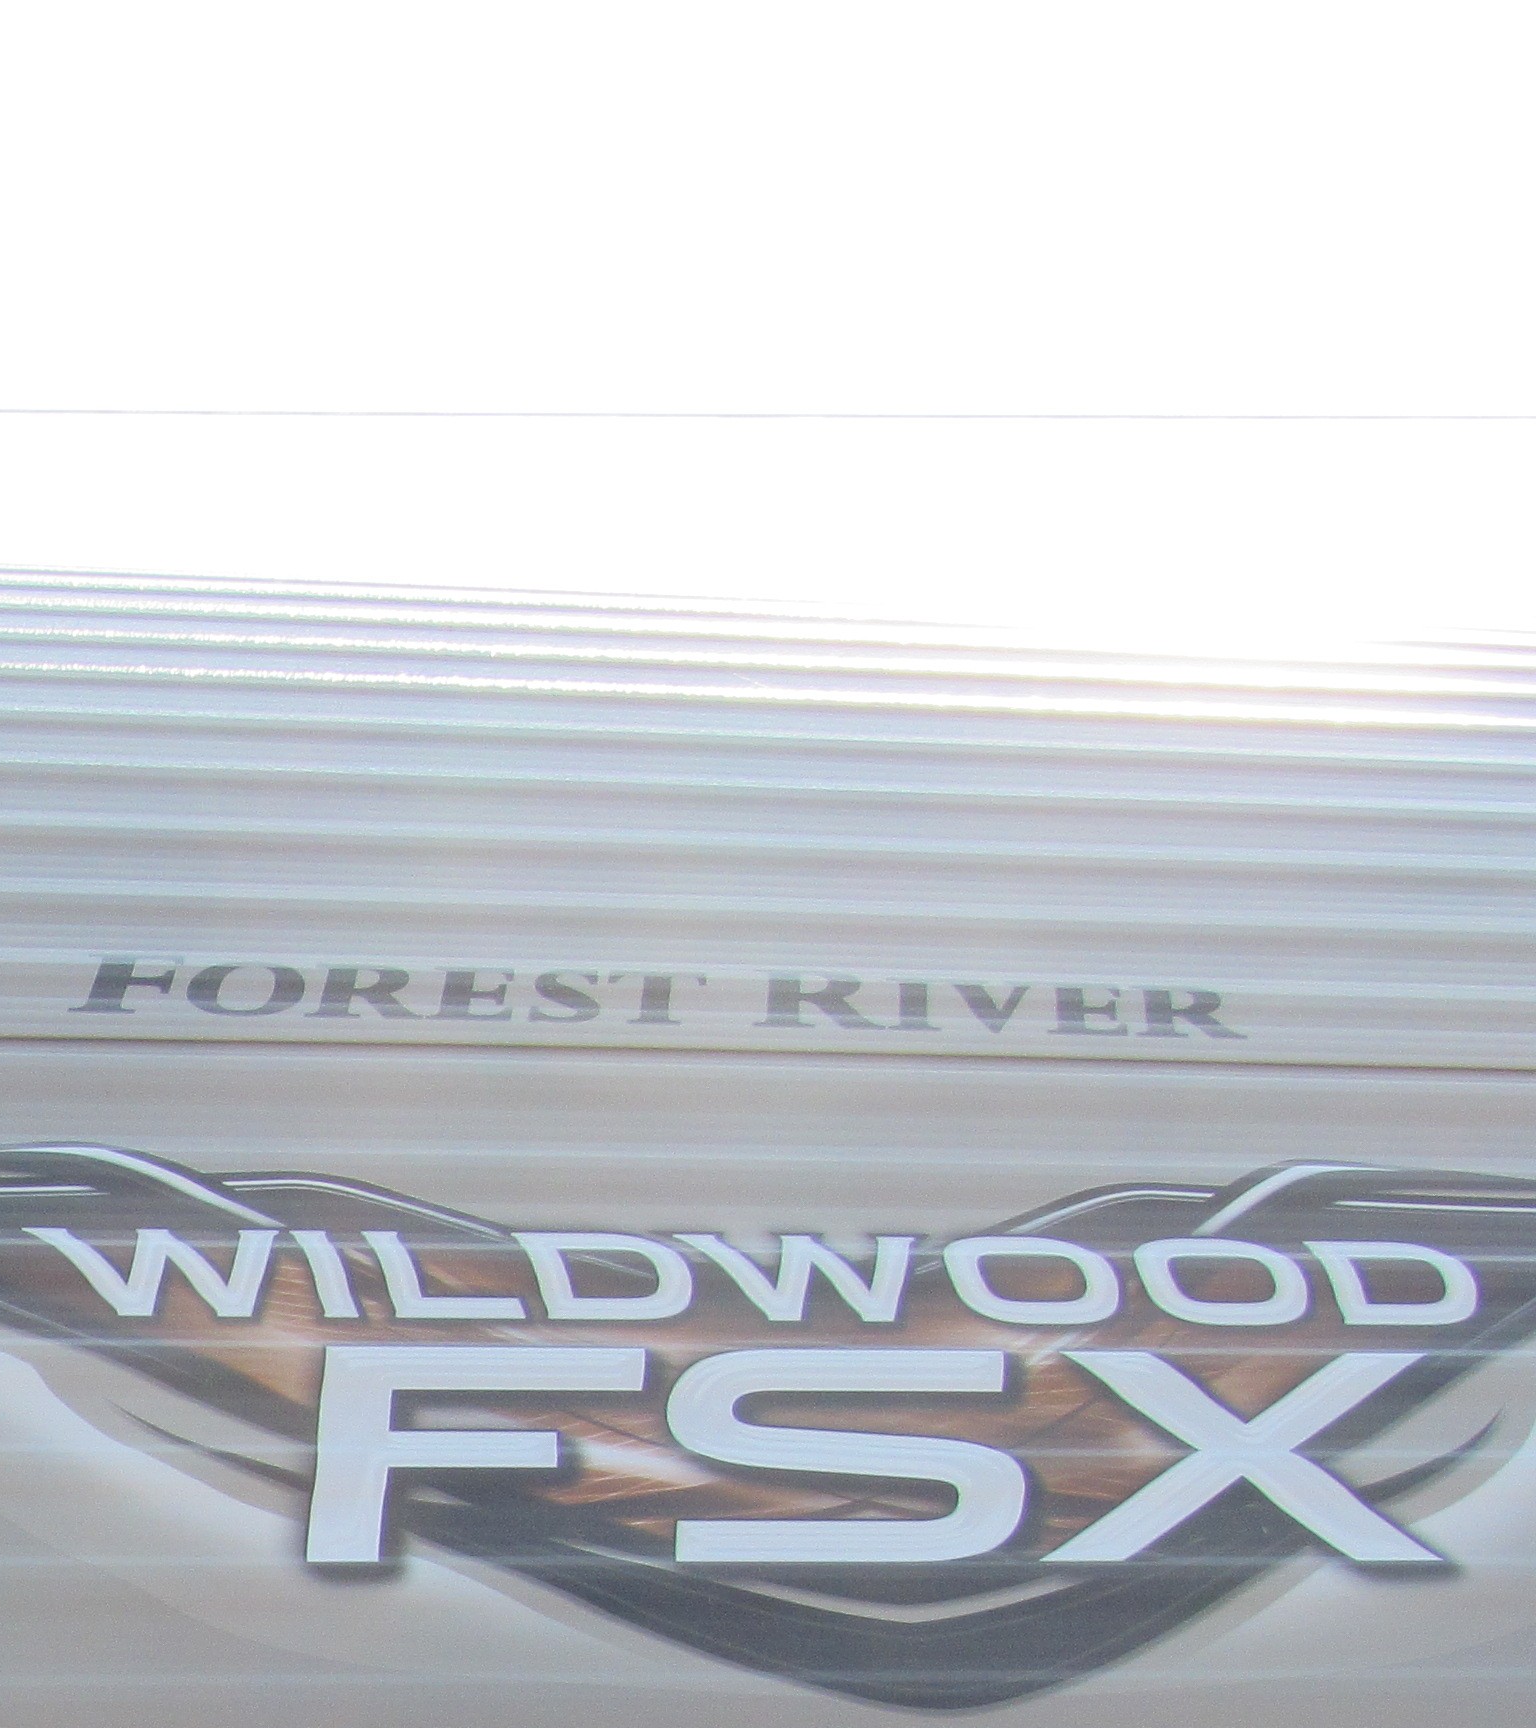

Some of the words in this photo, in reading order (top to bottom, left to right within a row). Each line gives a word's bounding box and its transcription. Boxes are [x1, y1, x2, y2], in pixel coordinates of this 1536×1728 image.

[68, 953, 708, 1026] FOREST
[752, 968, 1249, 1040] RIVER
[22, 1227, 1478, 1326] WILDWOOD
[305, 1346, 1446, 1563] FSX
